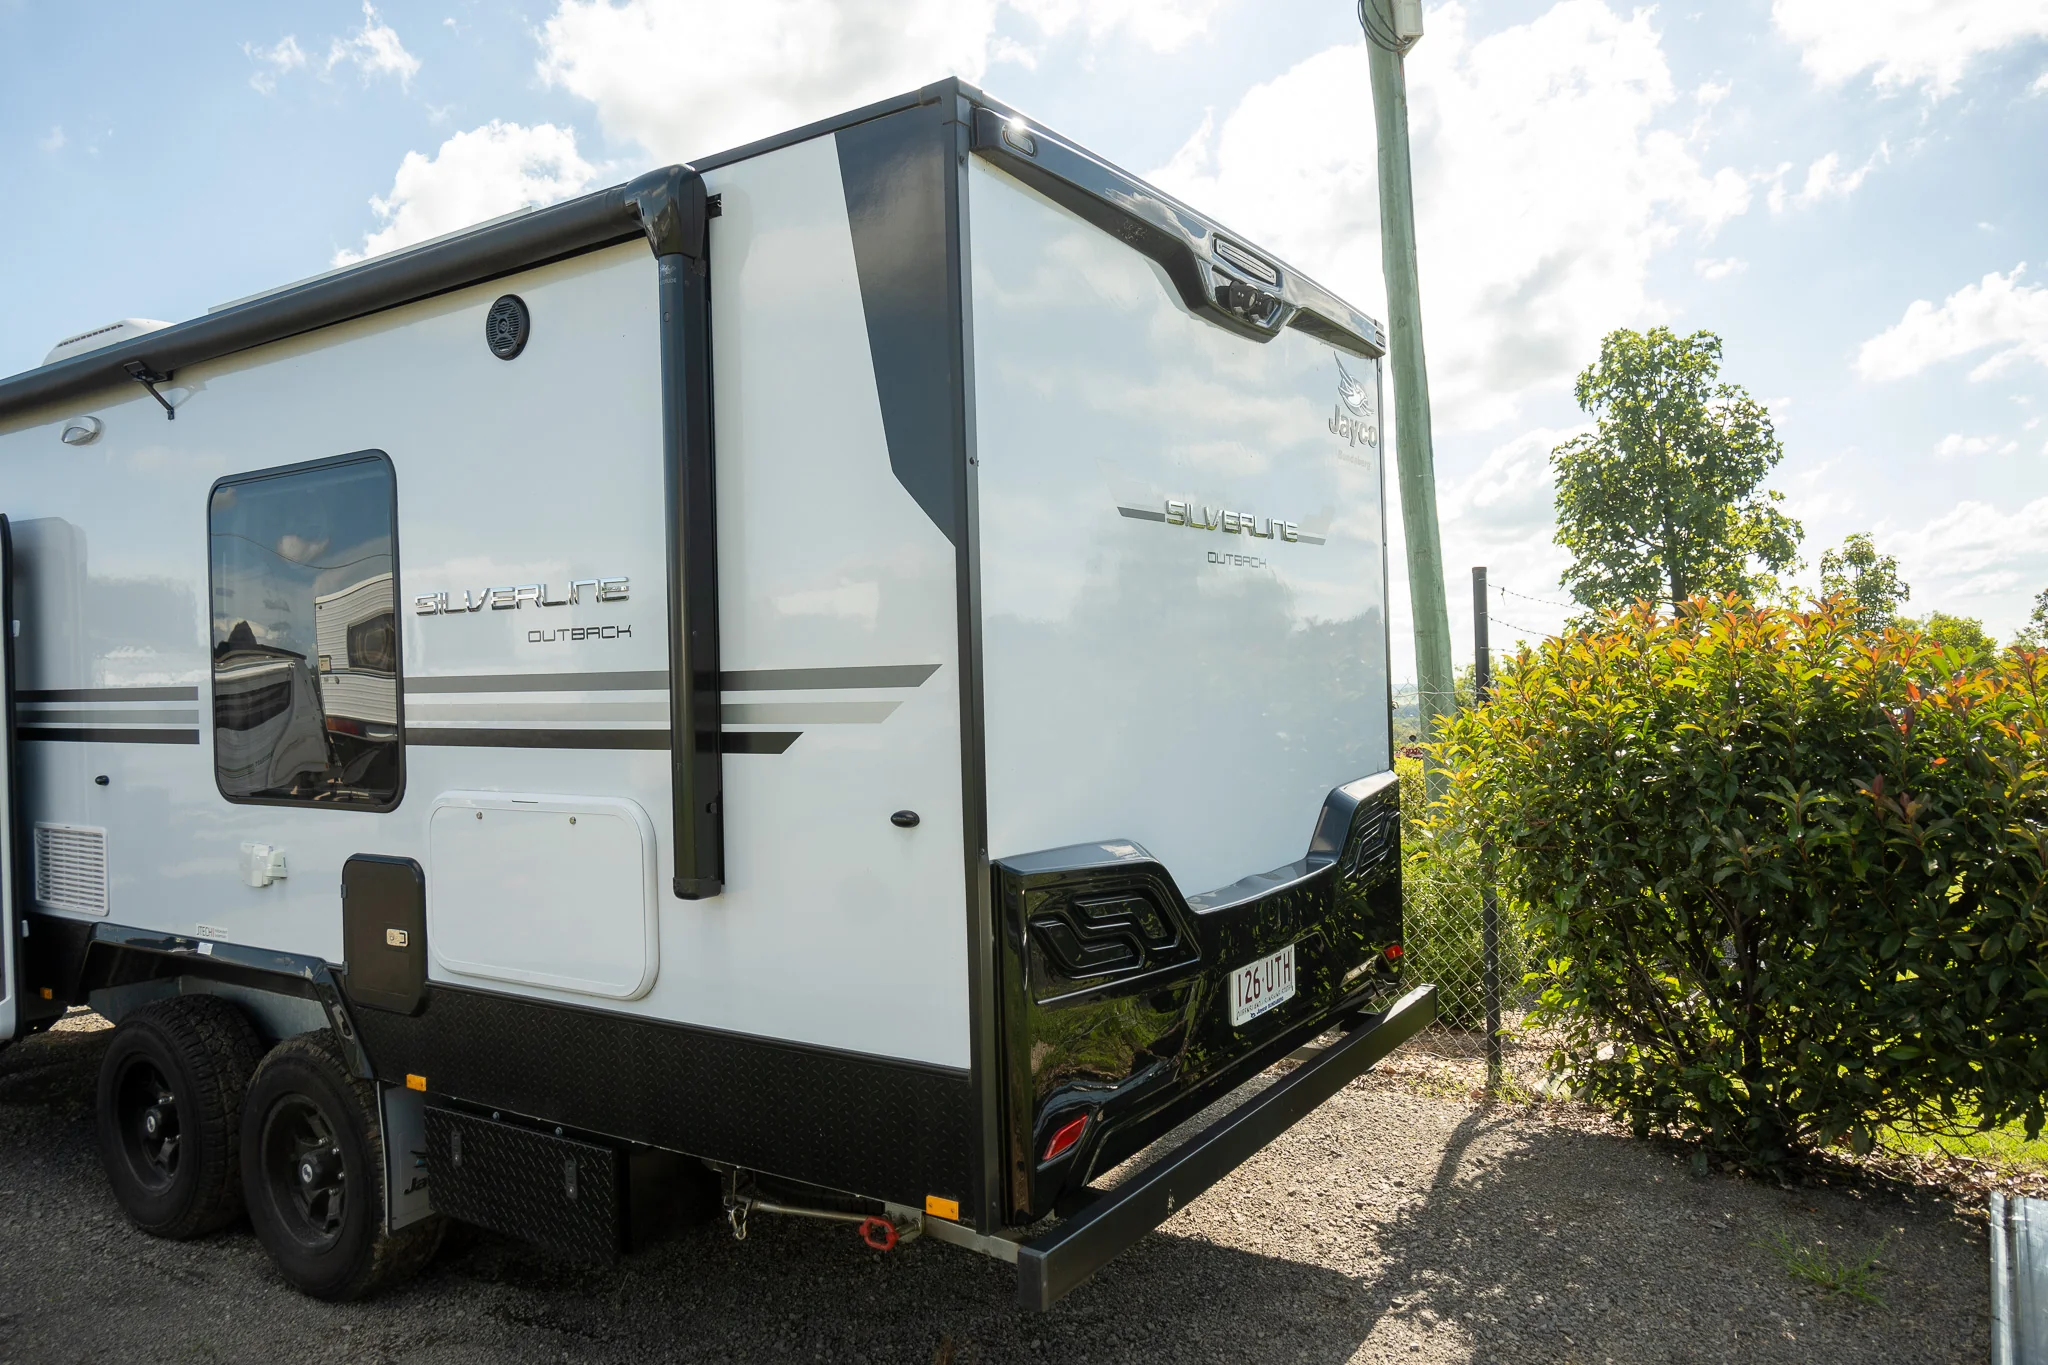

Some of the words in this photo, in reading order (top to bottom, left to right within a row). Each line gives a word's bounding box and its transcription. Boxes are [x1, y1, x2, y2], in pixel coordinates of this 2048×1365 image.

[1328, 404, 1378, 448] Jayco
[1166, 499, 1299, 543] SILVERLINE
[1207, 551, 1267, 569] OUTBACK
[415, 577, 630, 617] SILVERLINE
[528, 625, 632, 643] OUTBACK
